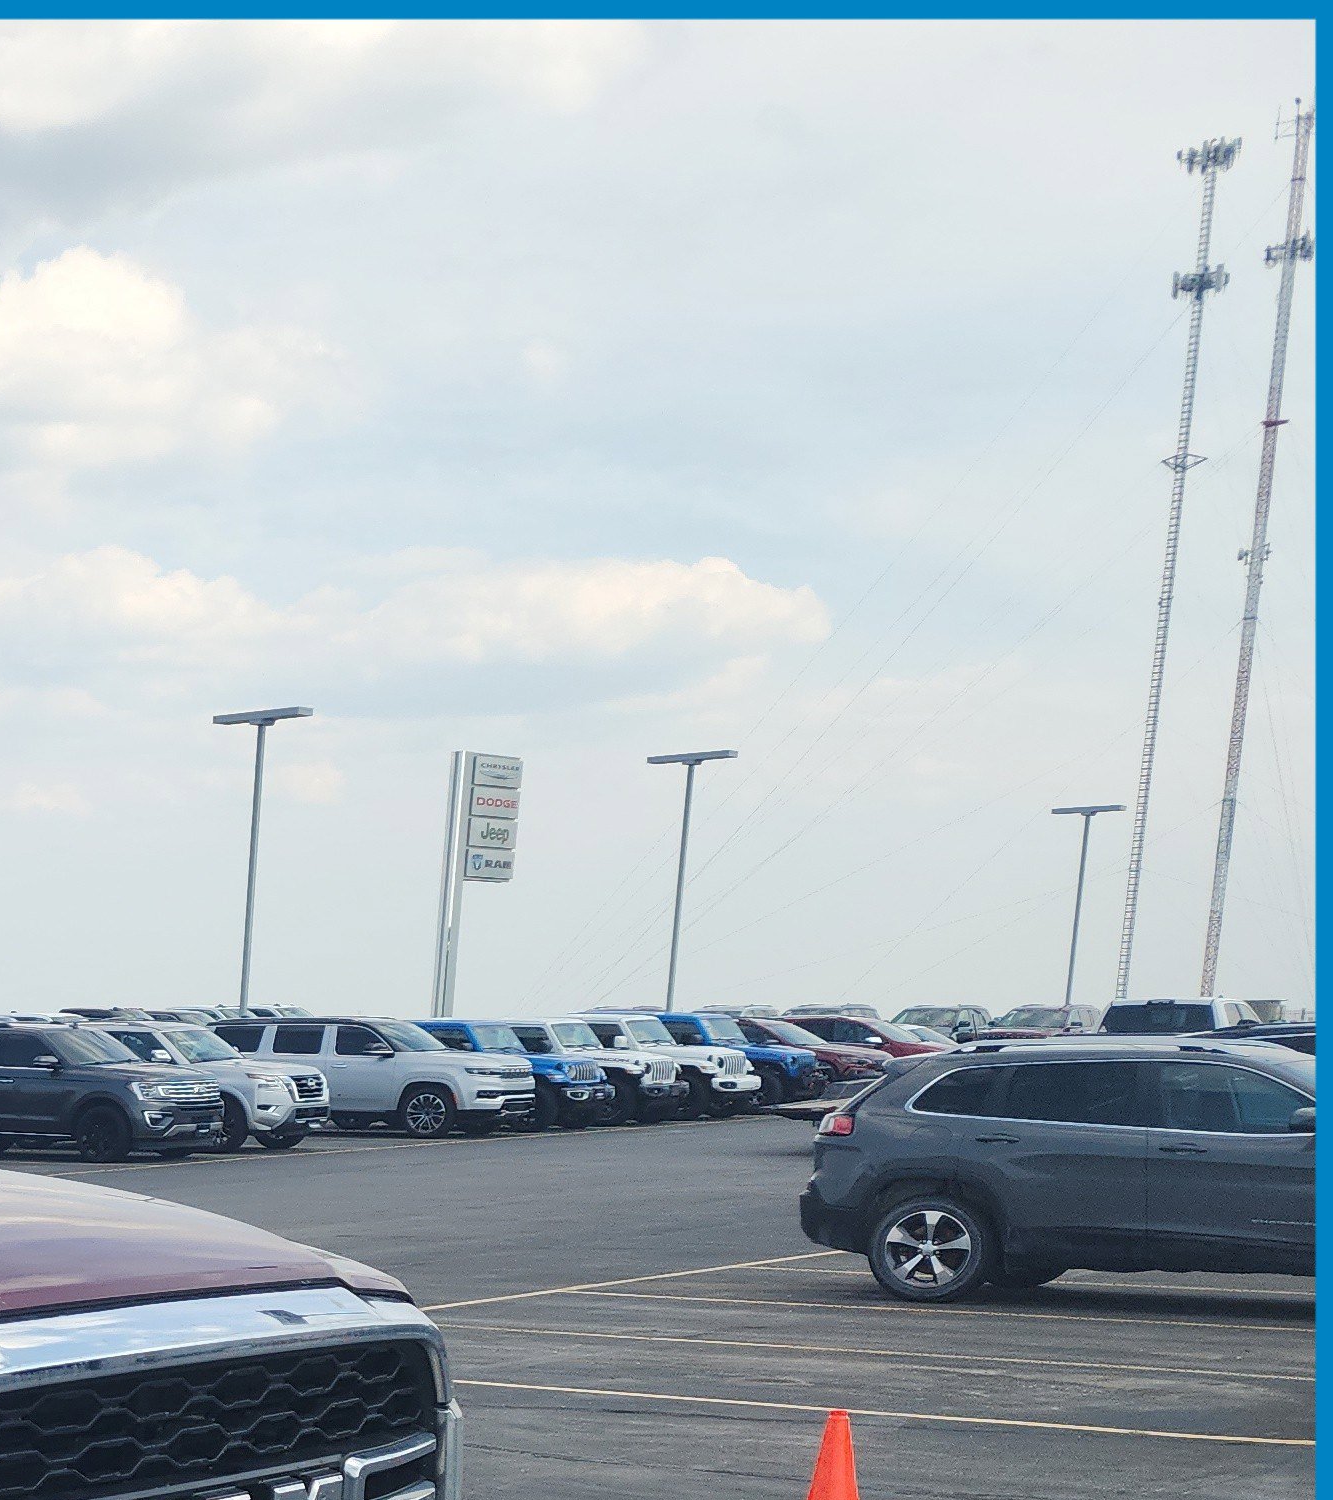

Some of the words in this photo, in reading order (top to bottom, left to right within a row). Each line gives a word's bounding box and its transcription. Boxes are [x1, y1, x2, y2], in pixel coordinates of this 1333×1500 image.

[480, 762, 521, 772] CHRYSLER
[476, 796, 519, 809] DODGE
[480, 822, 510, 845] Jeep
[484, 859, 512, 870] RAM
